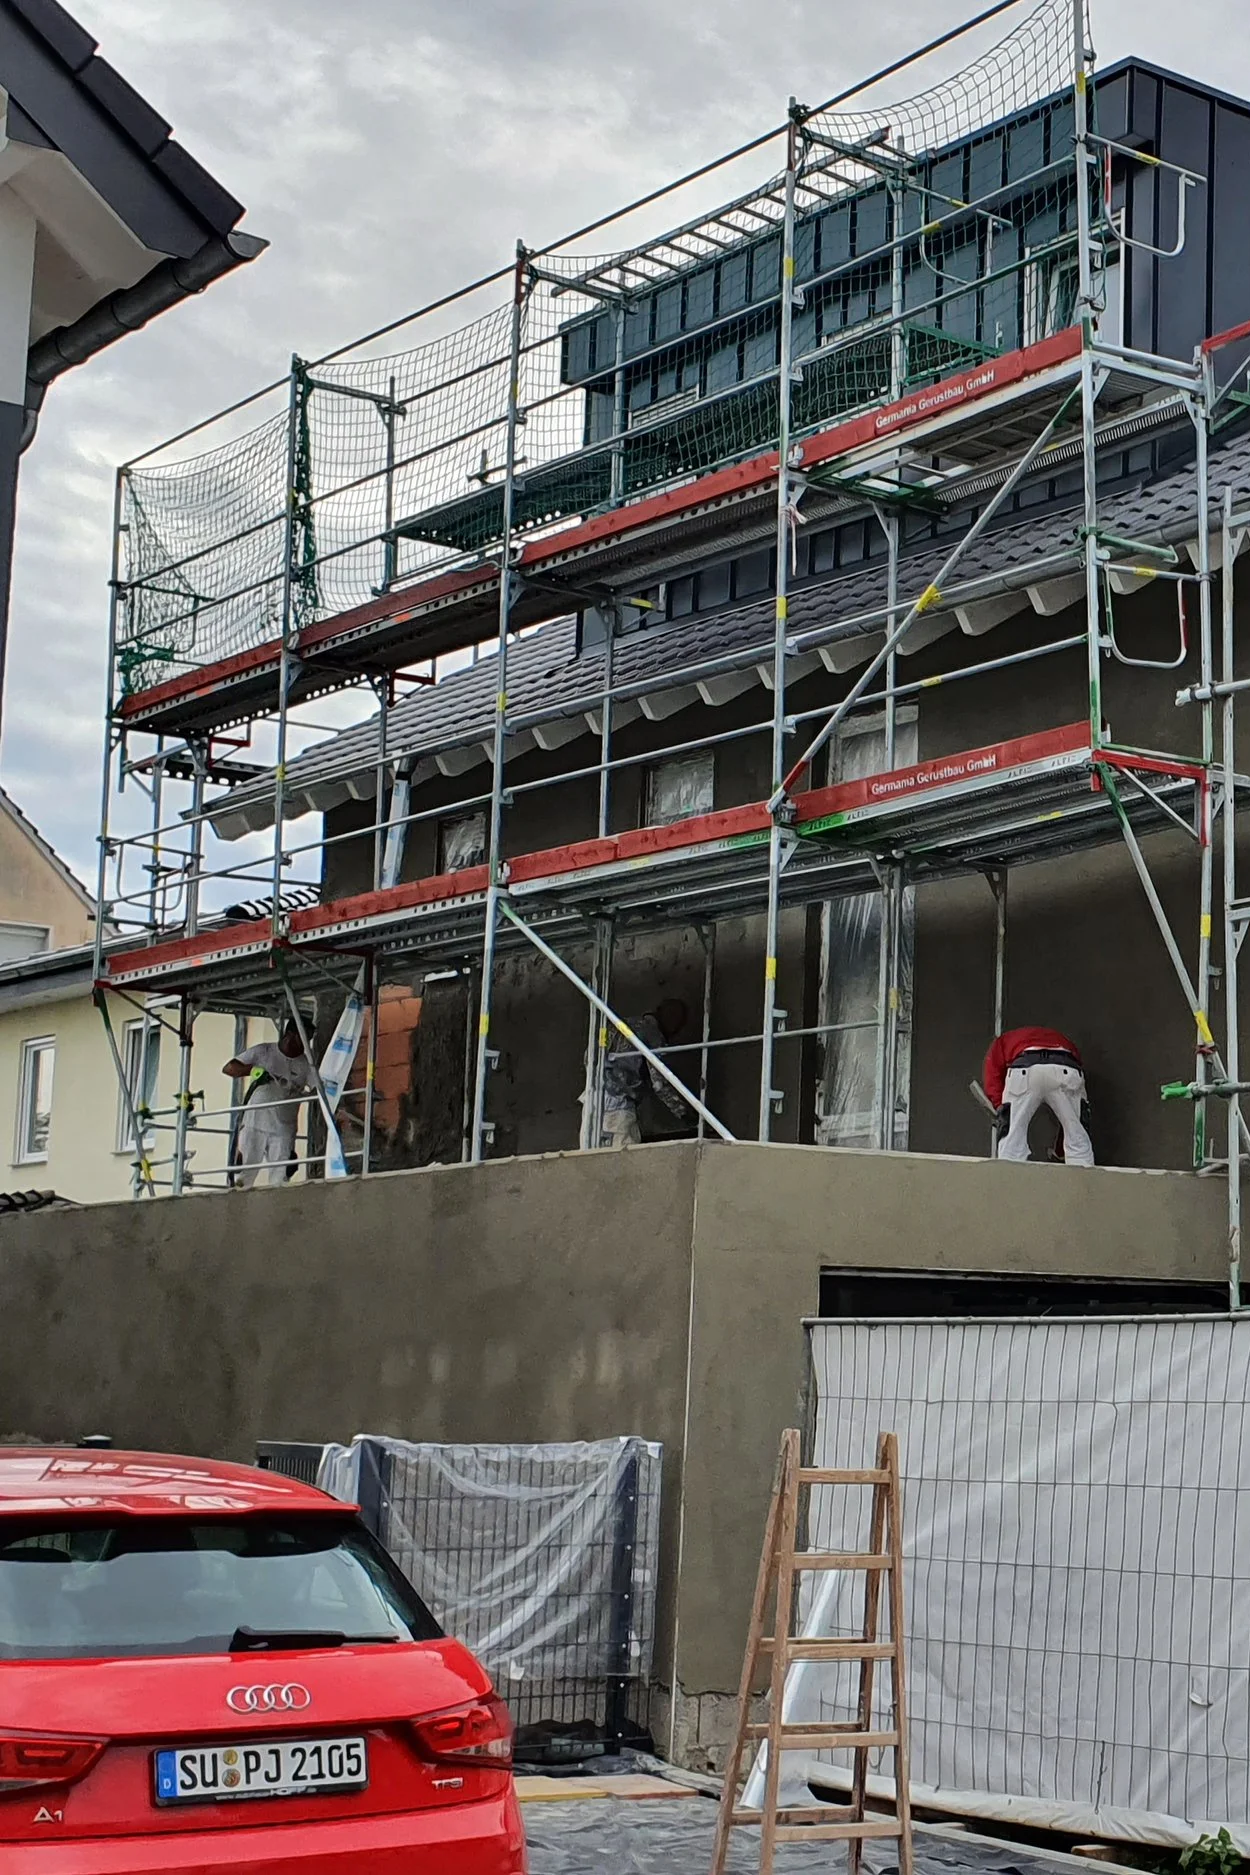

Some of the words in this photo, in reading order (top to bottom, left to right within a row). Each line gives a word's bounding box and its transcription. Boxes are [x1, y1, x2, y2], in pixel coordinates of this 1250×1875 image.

[180, 1753, 219, 1790] SU
[243, 1749, 282, 1785] PJ
[290, 1743, 363, 1782] 2105
[163, 1778, 172, 1789] D
[33, 1806, 63, 1823] A1
